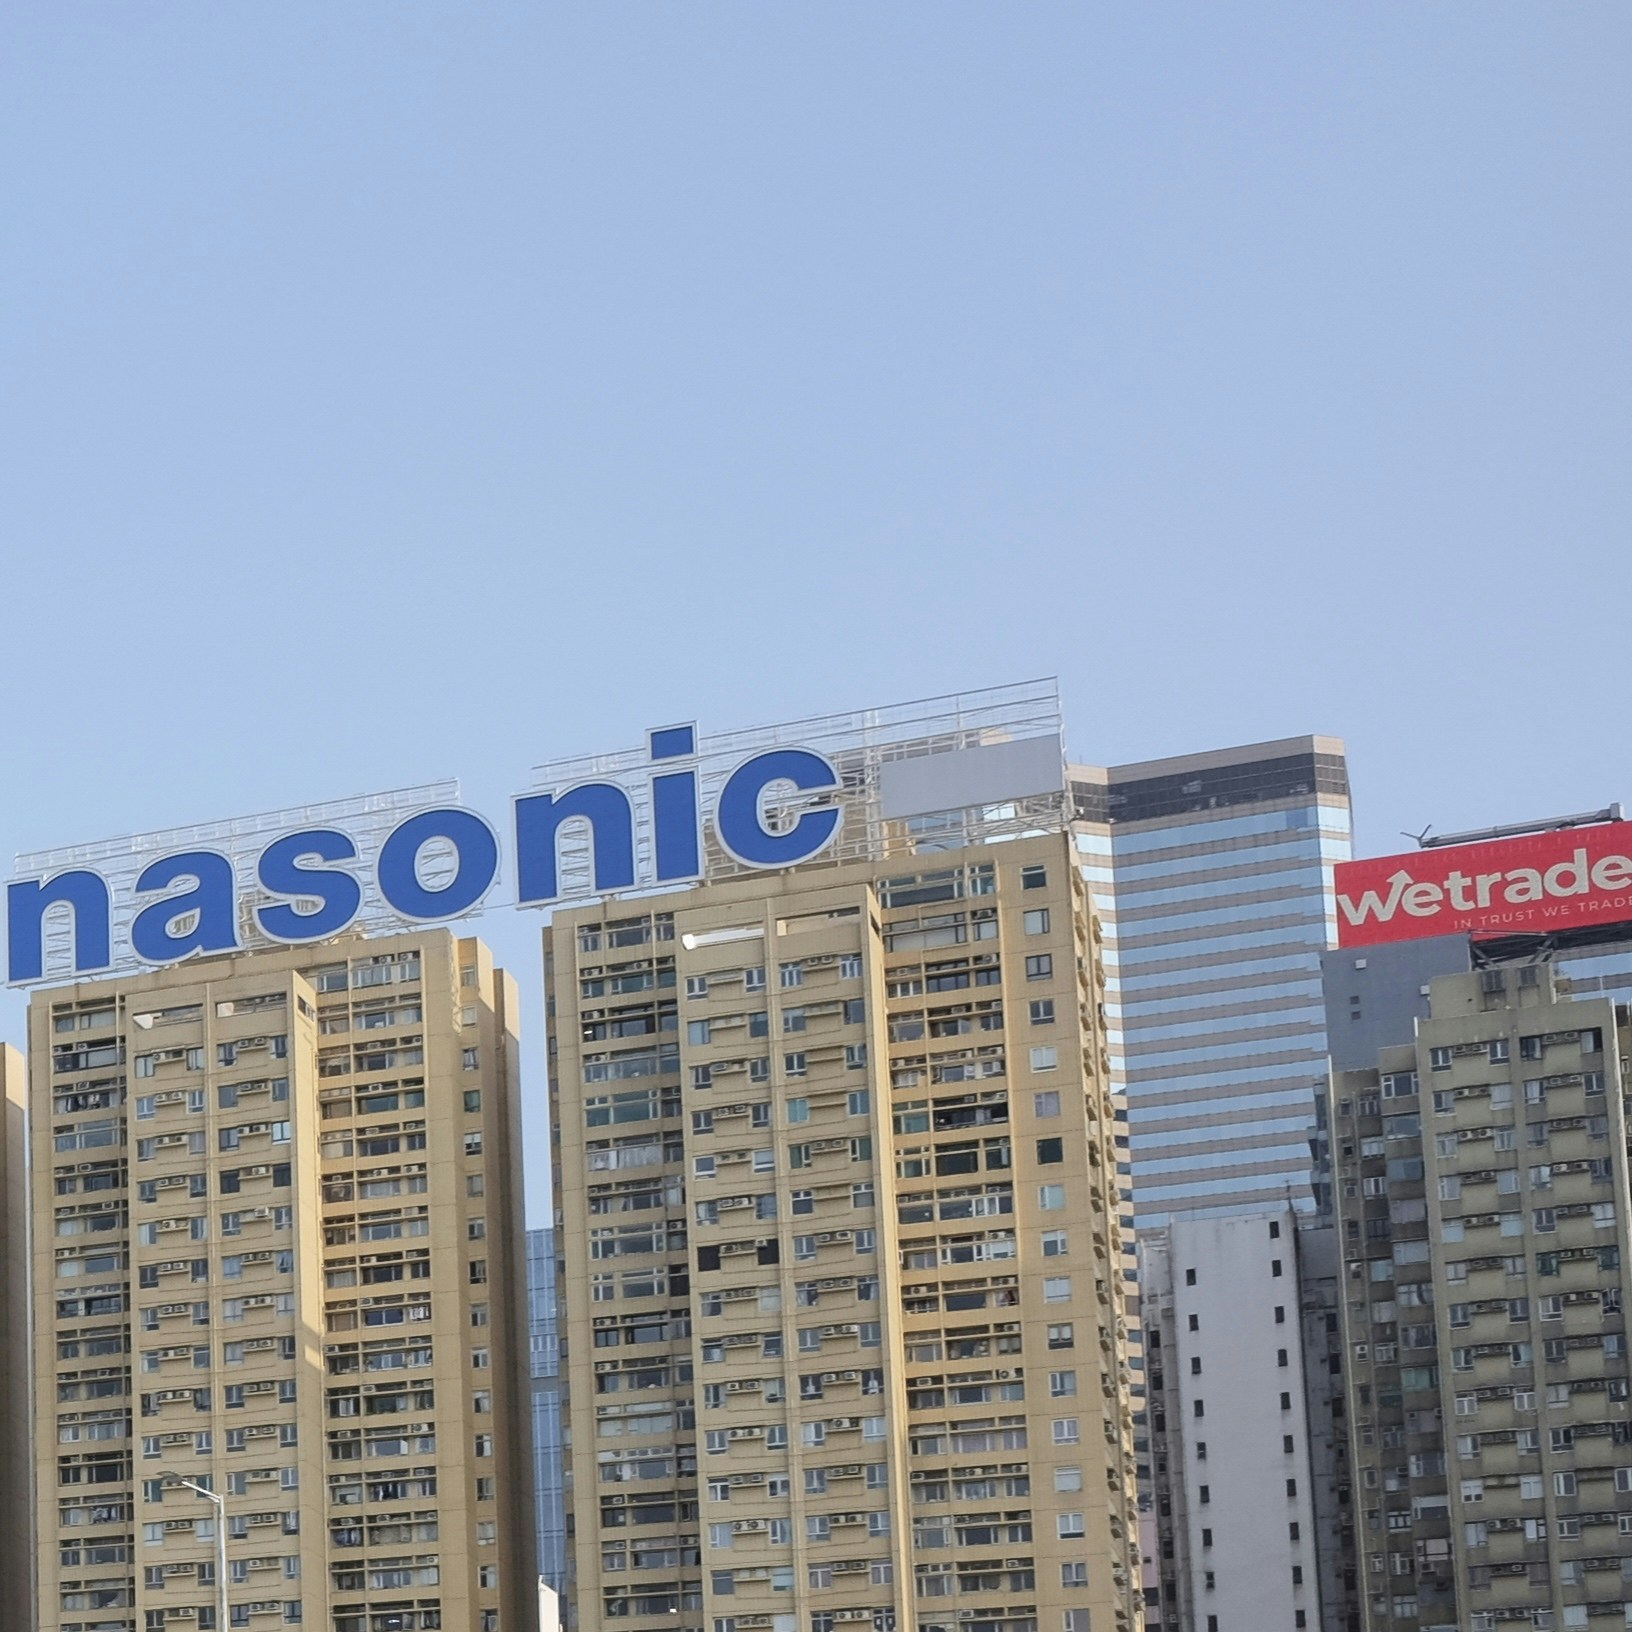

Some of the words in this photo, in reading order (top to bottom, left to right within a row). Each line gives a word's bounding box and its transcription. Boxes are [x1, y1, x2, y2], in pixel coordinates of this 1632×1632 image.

[1453, 918, 1472, 930] IN
[1479, 909, 1535, 926] TRUST
[1542, 904, 1570, 918] WE
